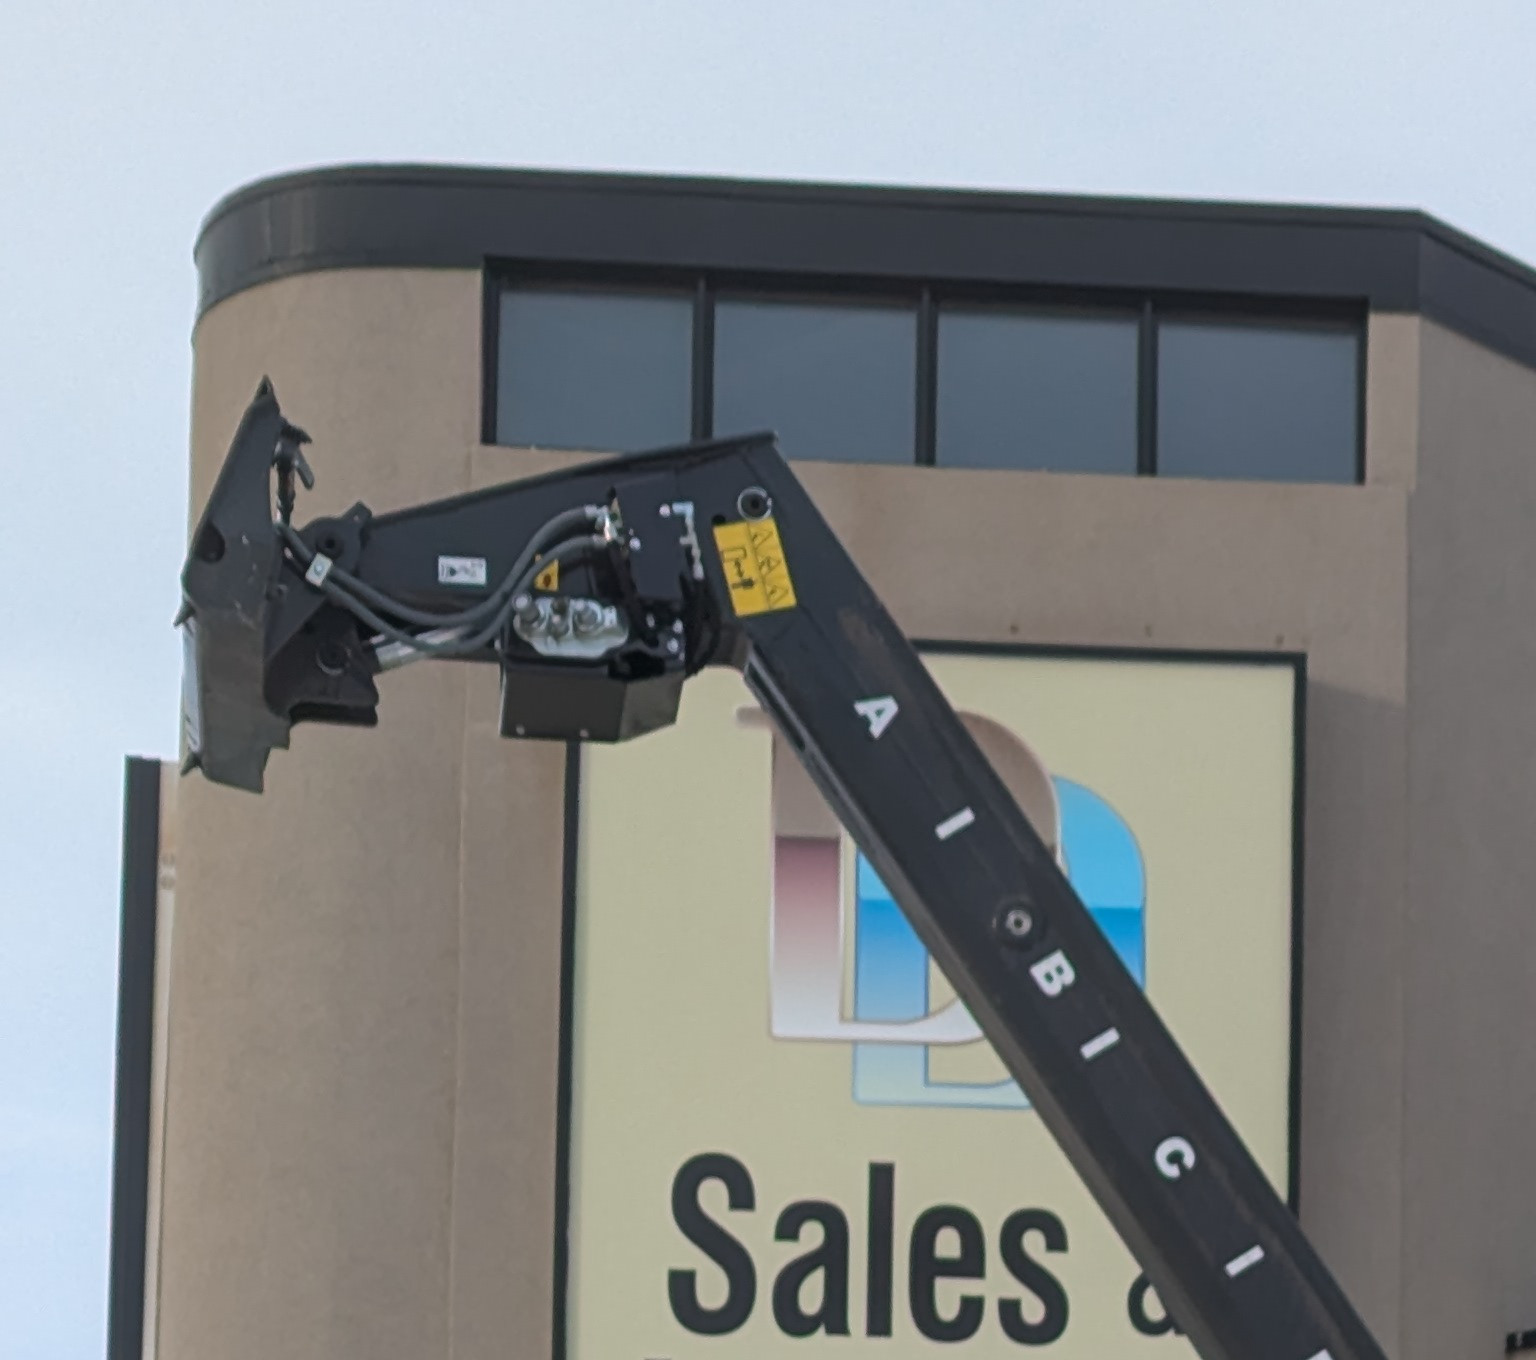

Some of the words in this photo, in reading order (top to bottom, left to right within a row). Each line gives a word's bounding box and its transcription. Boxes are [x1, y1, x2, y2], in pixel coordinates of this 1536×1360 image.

[854, 694, 899, 740] A
[1029, 950, 1077, 998] B
[1154, 1134, 1196, 1181] C
[667, 1150, 1070, 1347] Sales
